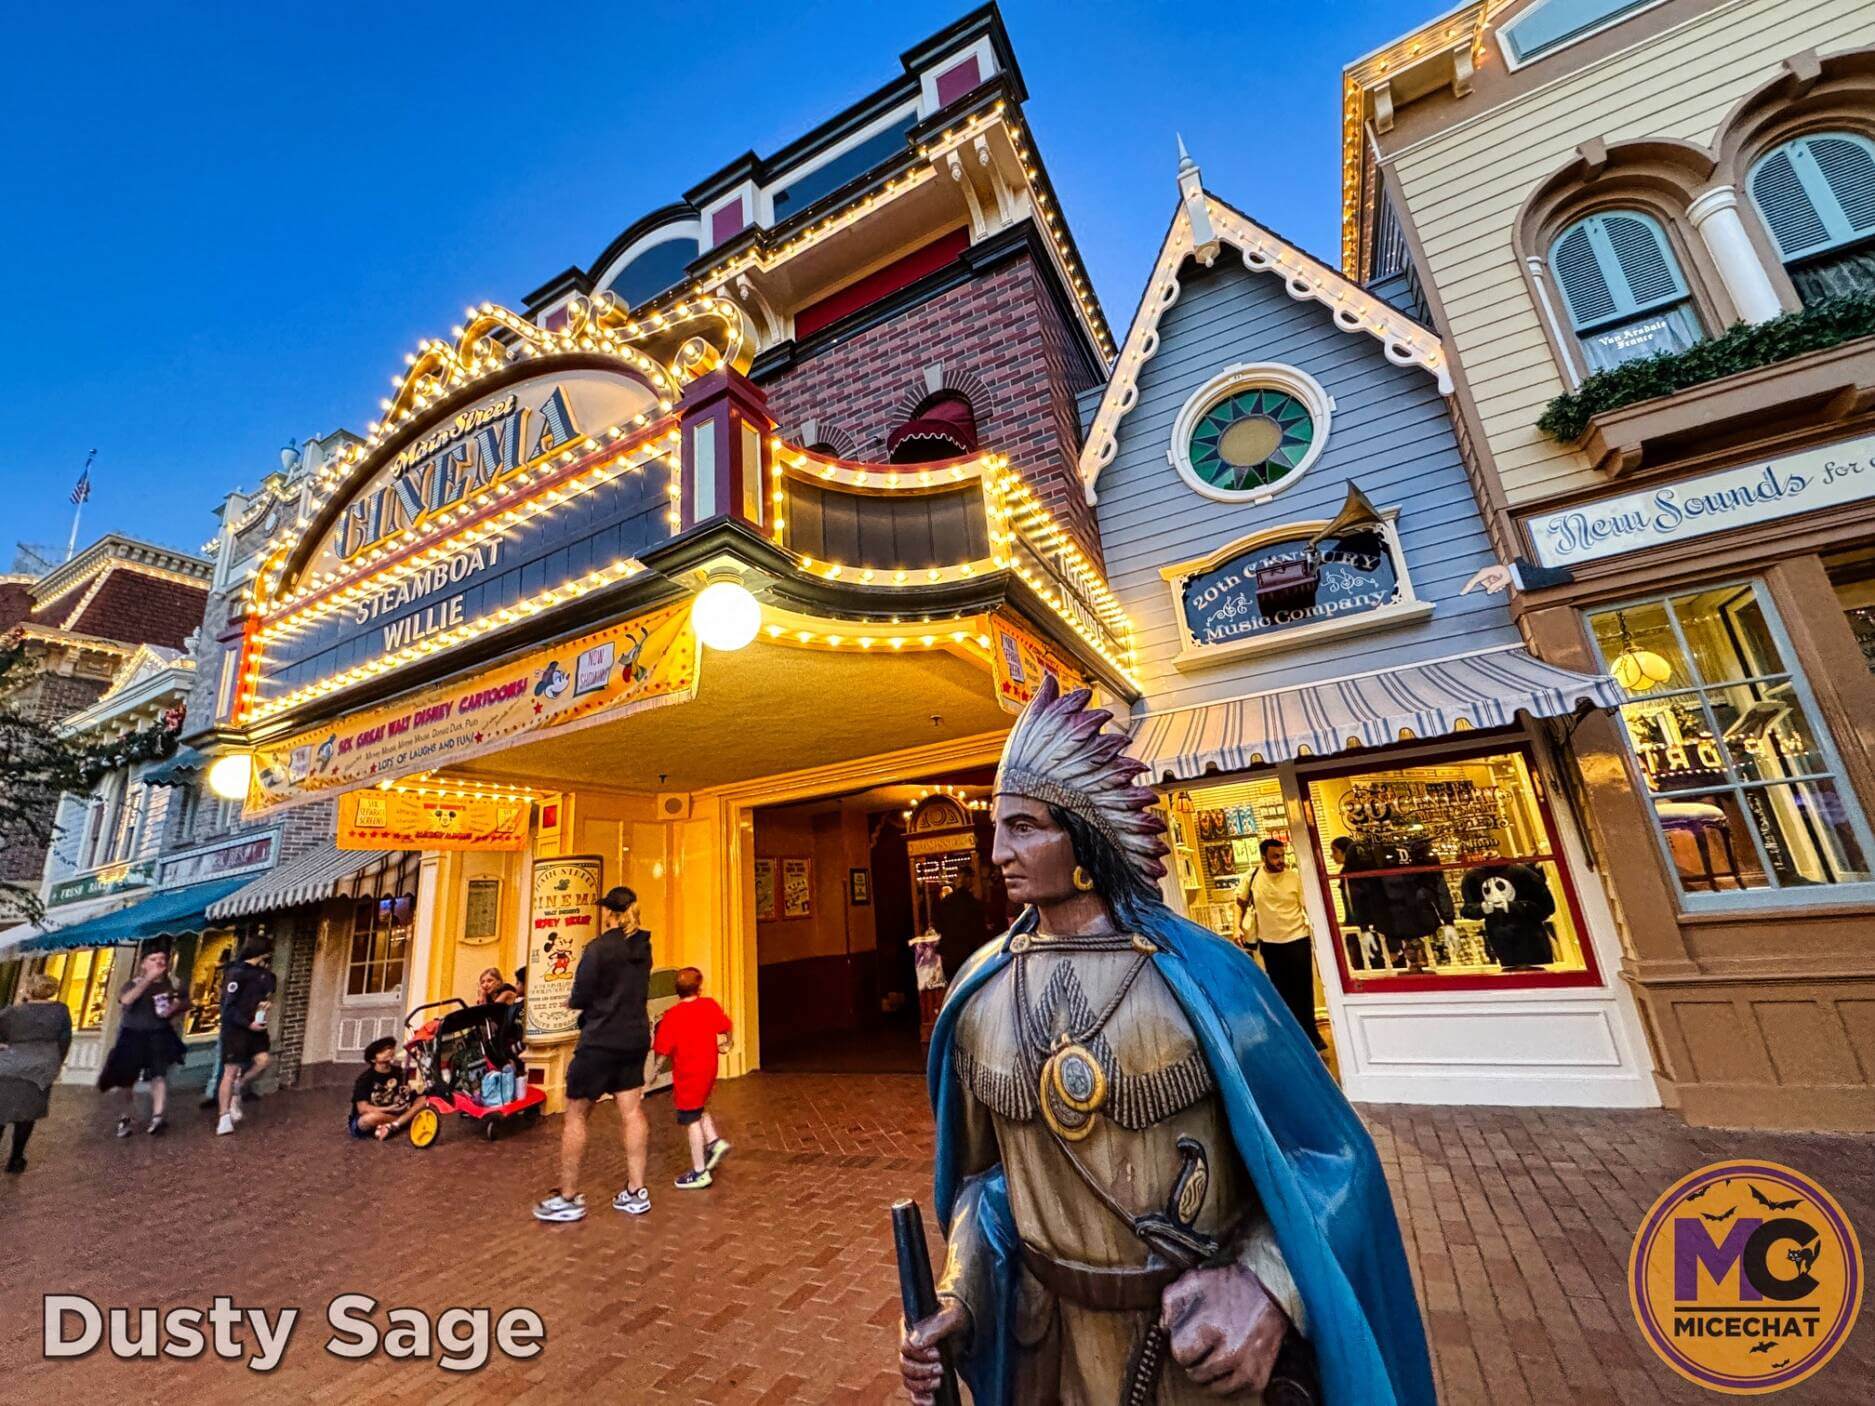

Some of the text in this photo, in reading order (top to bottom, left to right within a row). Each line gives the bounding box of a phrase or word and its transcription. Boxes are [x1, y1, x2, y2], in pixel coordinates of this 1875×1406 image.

[391, 393, 518, 478] Main Street
[334, 384, 588, 563] CINEMA
[1547, 461, 1865, 555] New Sounds for
[355, 537, 504, 625] STEAMBOAT
[1192, 573, 1242, 611] 20th
[383, 594, 465, 652] WILLIE
[1202, 589, 1389, 643] Music Company
[356, 725, 386, 749] GREAT
[387, 715, 412, 739] WALT
[413, 700, 454, 730] DISNEY
[396, 753, 408, 764] OF
[409, 742, 436, 760] LAUGHS
[438, 738, 455, 751] AND
[534, 893, 597, 910] INEMA
